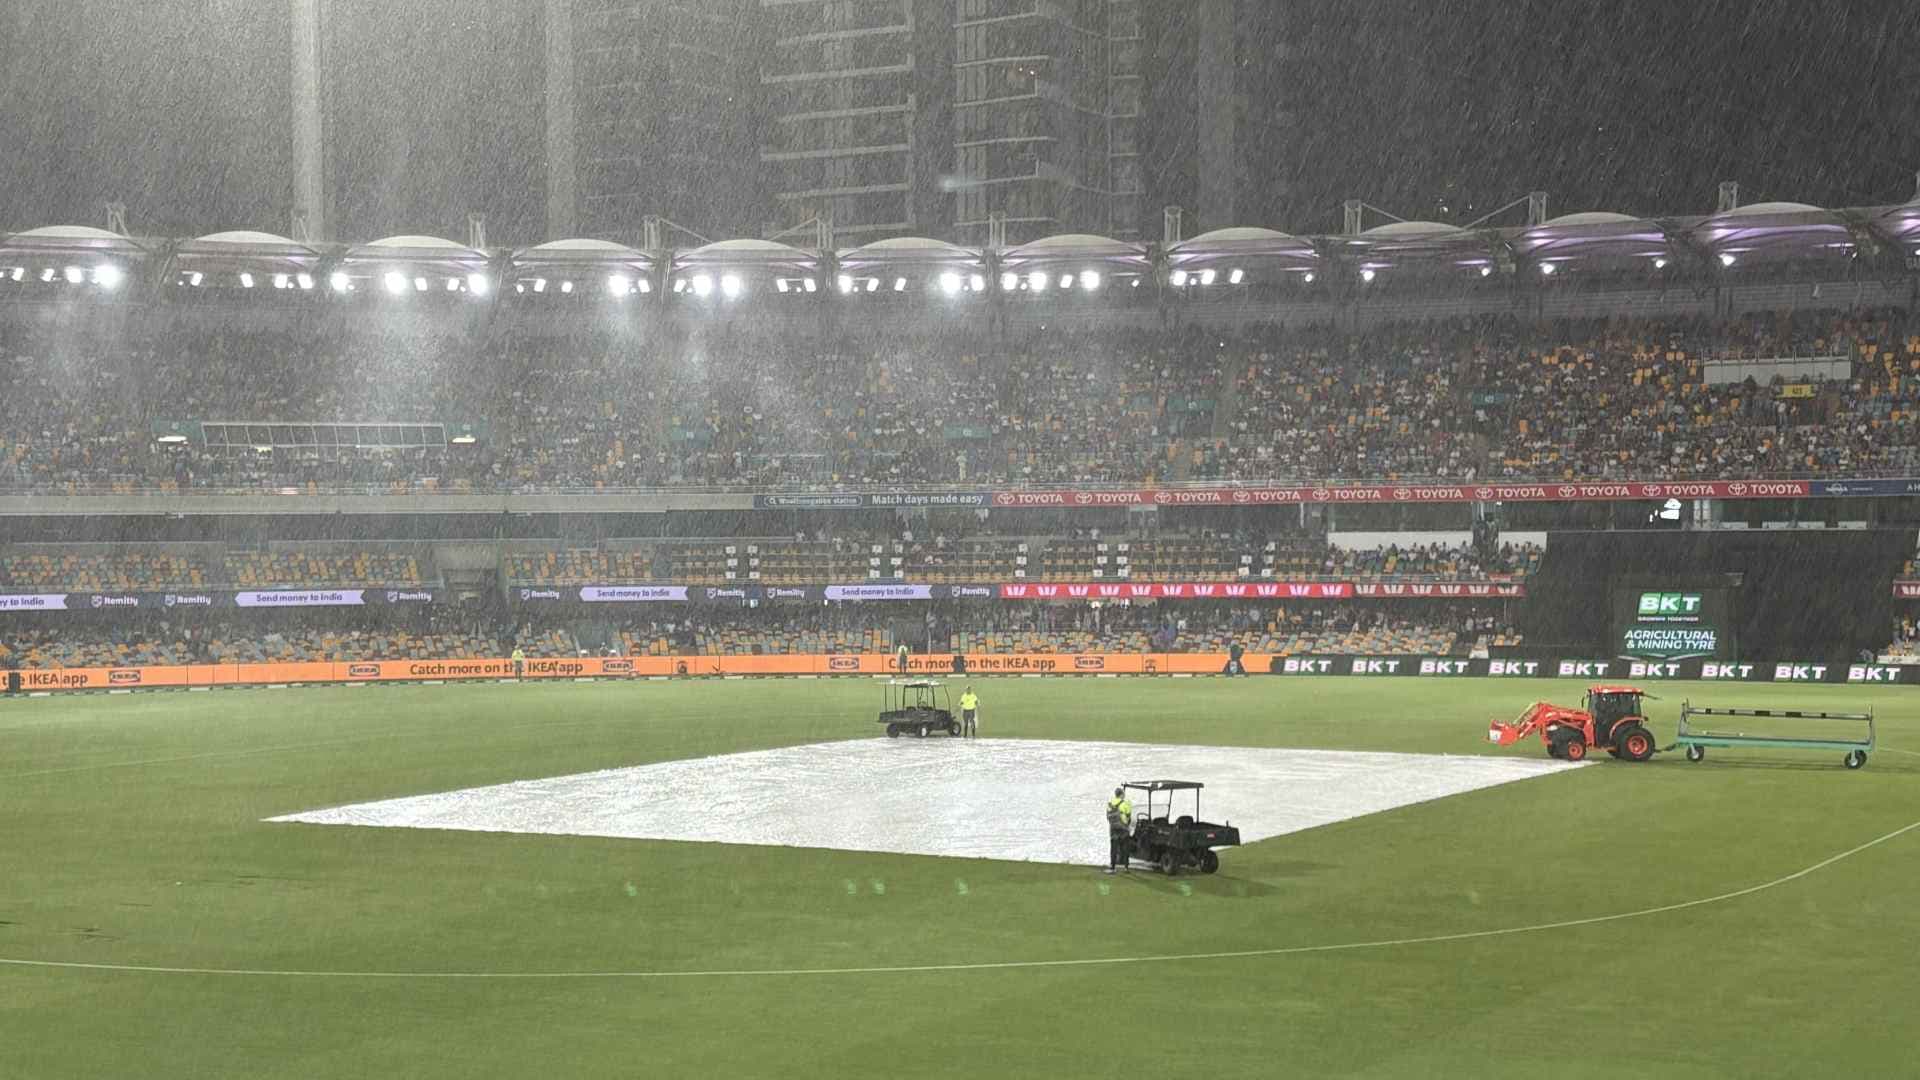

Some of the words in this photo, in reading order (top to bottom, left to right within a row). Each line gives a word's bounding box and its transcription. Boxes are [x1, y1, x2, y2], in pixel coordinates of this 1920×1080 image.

[1253, 490, 1301, 501] TOYOTA
[1334, 490, 1381, 499] TOYOTA
[1415, 489, 1463, 499] TOYOTA
[1498, 488, 1545, 498] TOYOTA
[1580, 487, 1630, 496] TOYOTA
[1664, 486, 1715, 496] TOYOTA
[1751, 485, 1802, 495] TOYOTA
[872, 494, 902, 504] Match
[905, 494, 928, 505] days
[930, 494, 959, 504] made
[961, 495, 984, 505] easy
[1018, 493, 1064, 504] TOYOTA
[1096, 492, 1142, 503] TOYOTA
[1174, 491, 1221, 502] TOYOTA
[399, 592, 432, 602] Remitly
[616, 590, 641, 598] money
[651, 589, 670, 597] India
[717, 589, 745, 599] Remitly
[842, 588, 860, 596] Send
[861, 589, 885, 597] money
[887, 588, 894, 596] to
[896, 588, 914, 596] India
[961, 587, 990, 597] Remitly
[21, 597, 44, 605] India
[104, 596, 138, 607] Remitly
[177, 595, 211, 606] Remitly
[257, 594, 278, 602] Send
[280, 595, 308, 604] money
[321, 593, 343, 601] India
[1639, 597, 1700, 611] BKT
[1624, 630, 1717, 640] AGRICULTURAL
[1626, 640, 1635, 649] &
[1637, 640, 1682, 649] MINING
[1686, 640, 1716, 650] TYRE
[410, 664, 446, 675] Catch
[448, 664, 481, 675] more
[484, 664, 500, 674] on
[504, 663, 523, 673] th
[528, 661, 556, 673] IKEA
[559, 663, 583, 675] app
[889, 658, 922, 669] Cch
[980, 658, 1000, 669] the
[1003, 657, 1031, 669] IKEA
[1033, 660, 1056, 670] app
[1284, 660, 1331, 672] BKT
[1353, 661, 1399, 672] BKT
[1423, 662, 1468, 673] BKT
[1491, 662, 1538, 674] BKT
[1560, 663, 1609, 675] BKT
[1631, 664, 1680, 676] BKT
[1703, 665, 1753, 677] BKT
[1776, 666, 1826, 679] BKT
[1850, 667, 1900, 680] BKT
[2, 673, 26, 686] te
[29, 673, 59, 685] IKEA
[62, 673, 88, 687] app
